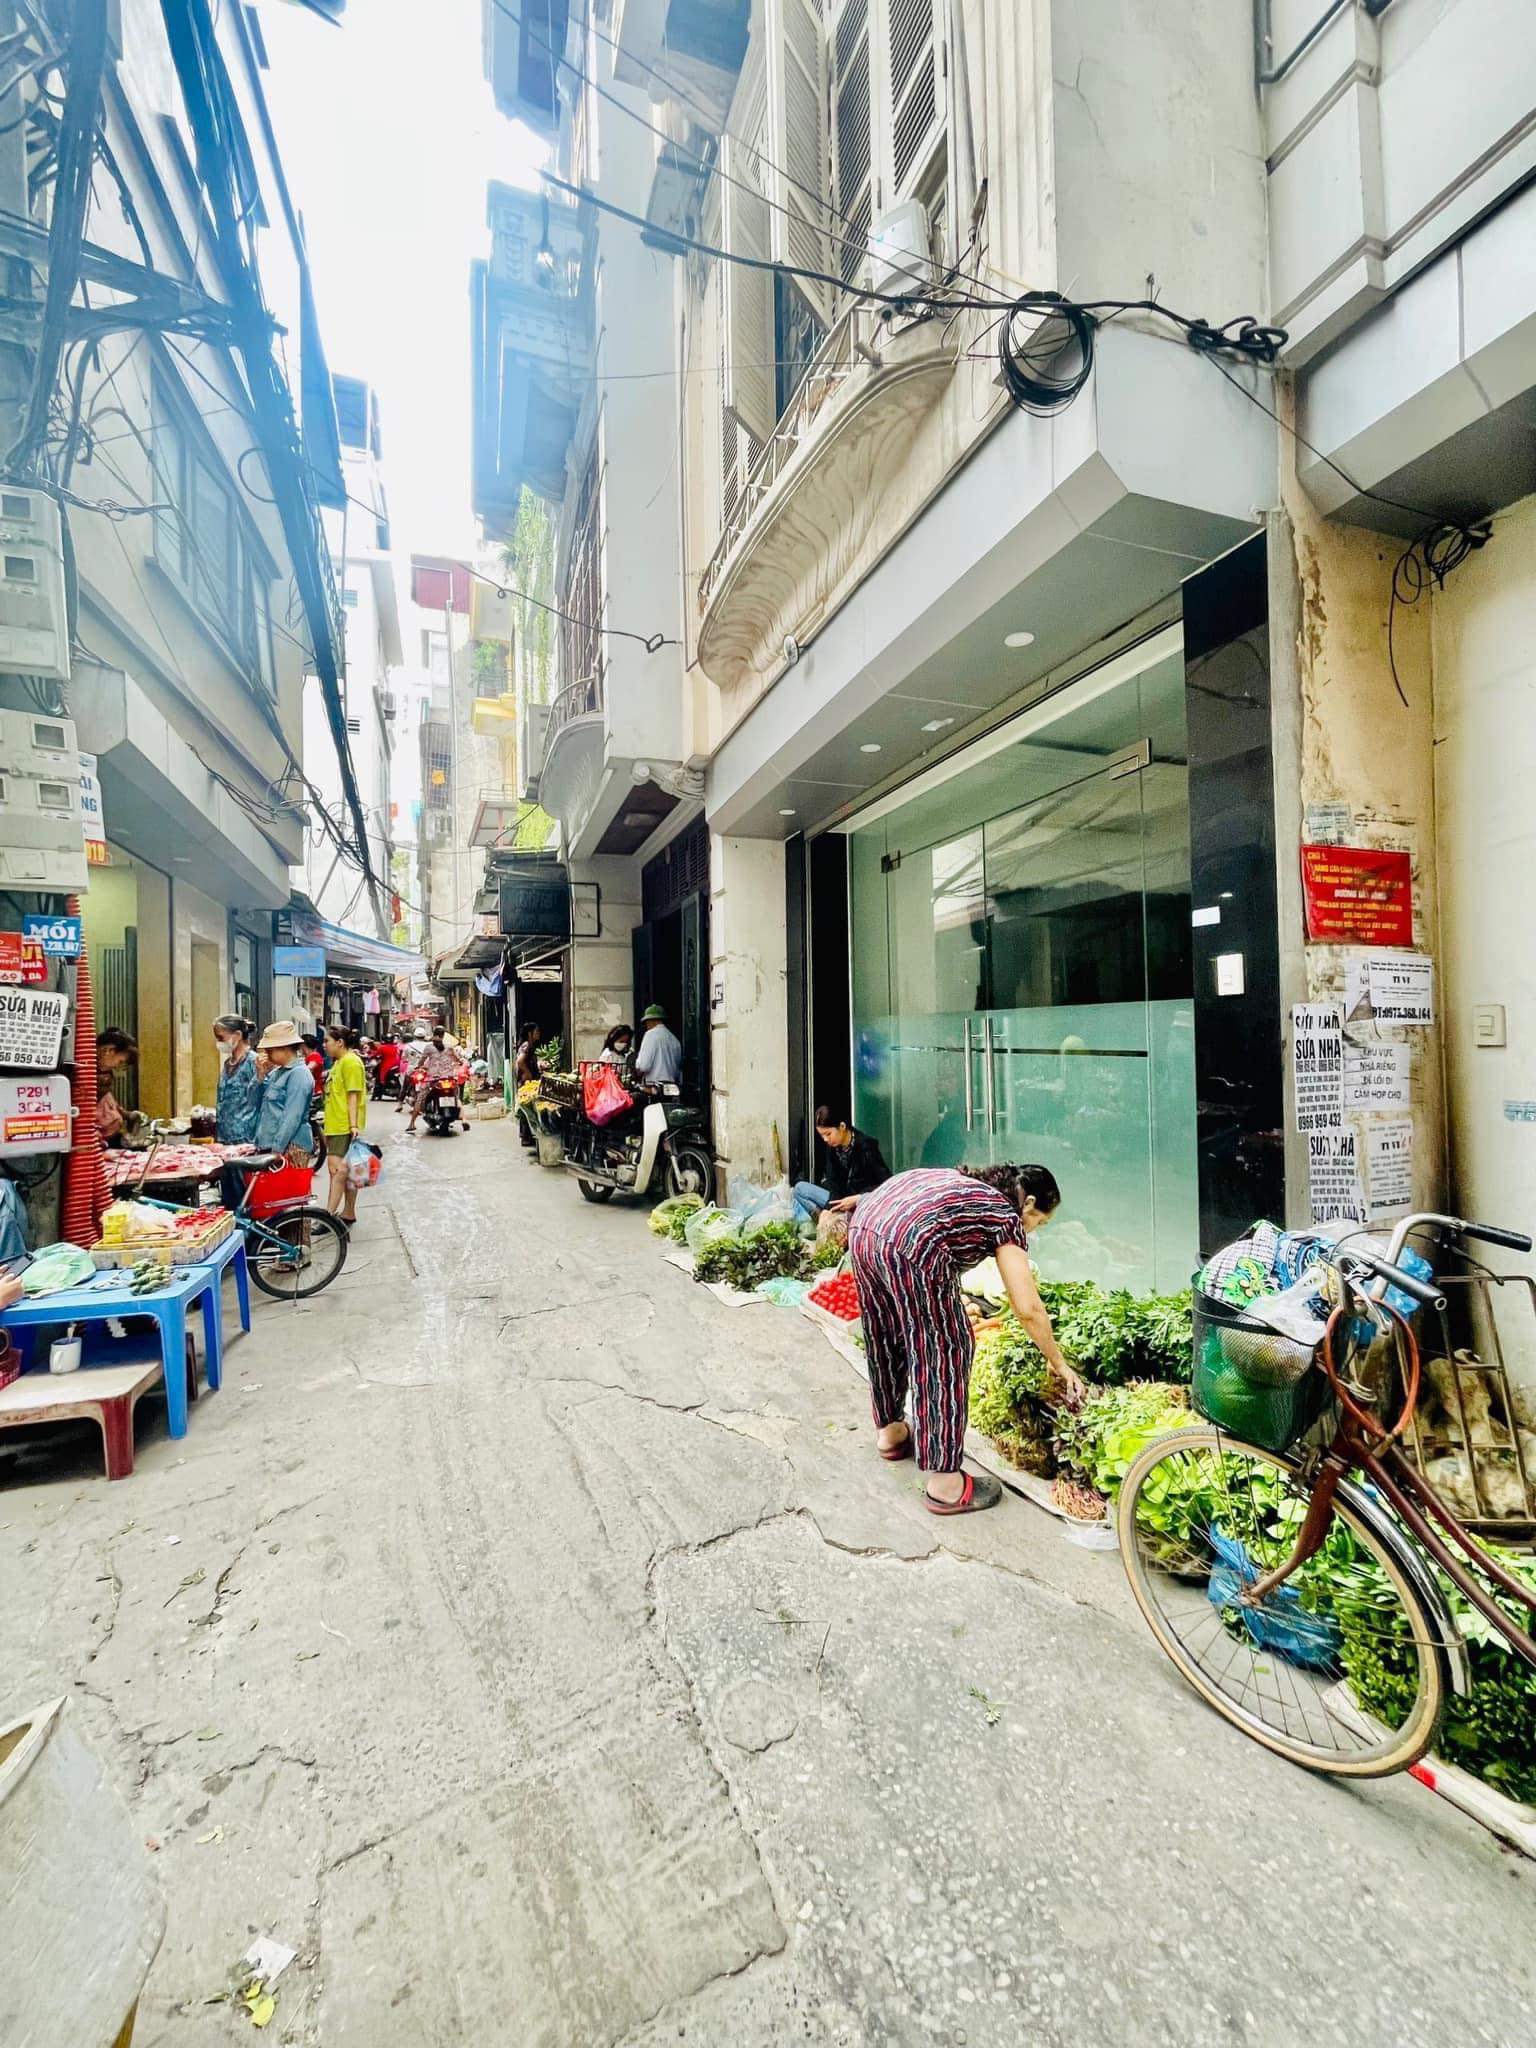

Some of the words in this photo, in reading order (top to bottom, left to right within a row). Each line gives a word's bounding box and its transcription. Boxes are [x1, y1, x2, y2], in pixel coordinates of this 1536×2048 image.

[32, 999, 61, 1017] NHÀ
[1295, 1030, 1316, 1059] SỬA
[1319, 1034, 1341, 1058] NHÀ
[17, 1086, 49, 1098] P291
